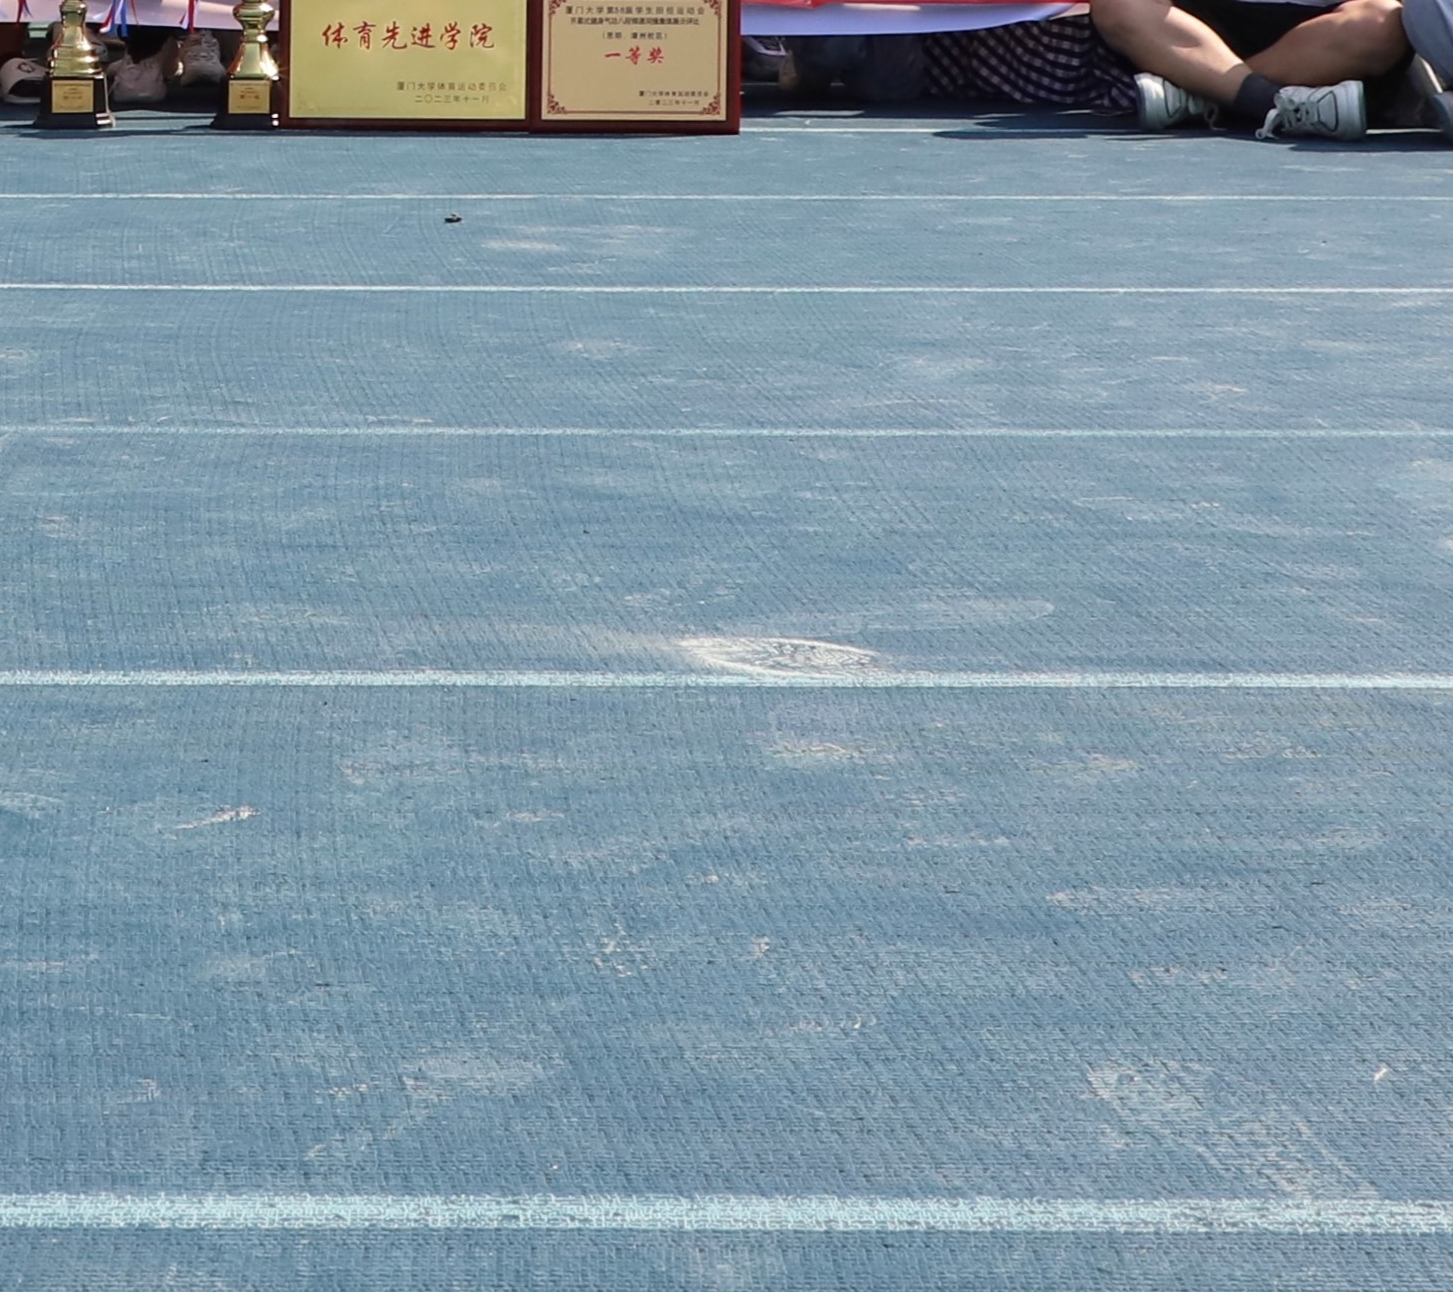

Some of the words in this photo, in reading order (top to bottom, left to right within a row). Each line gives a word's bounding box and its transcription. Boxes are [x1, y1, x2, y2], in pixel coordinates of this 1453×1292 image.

[321, 20, 496, 51] 体育先进学院
[604, 44, 665, 65] 一等奖
